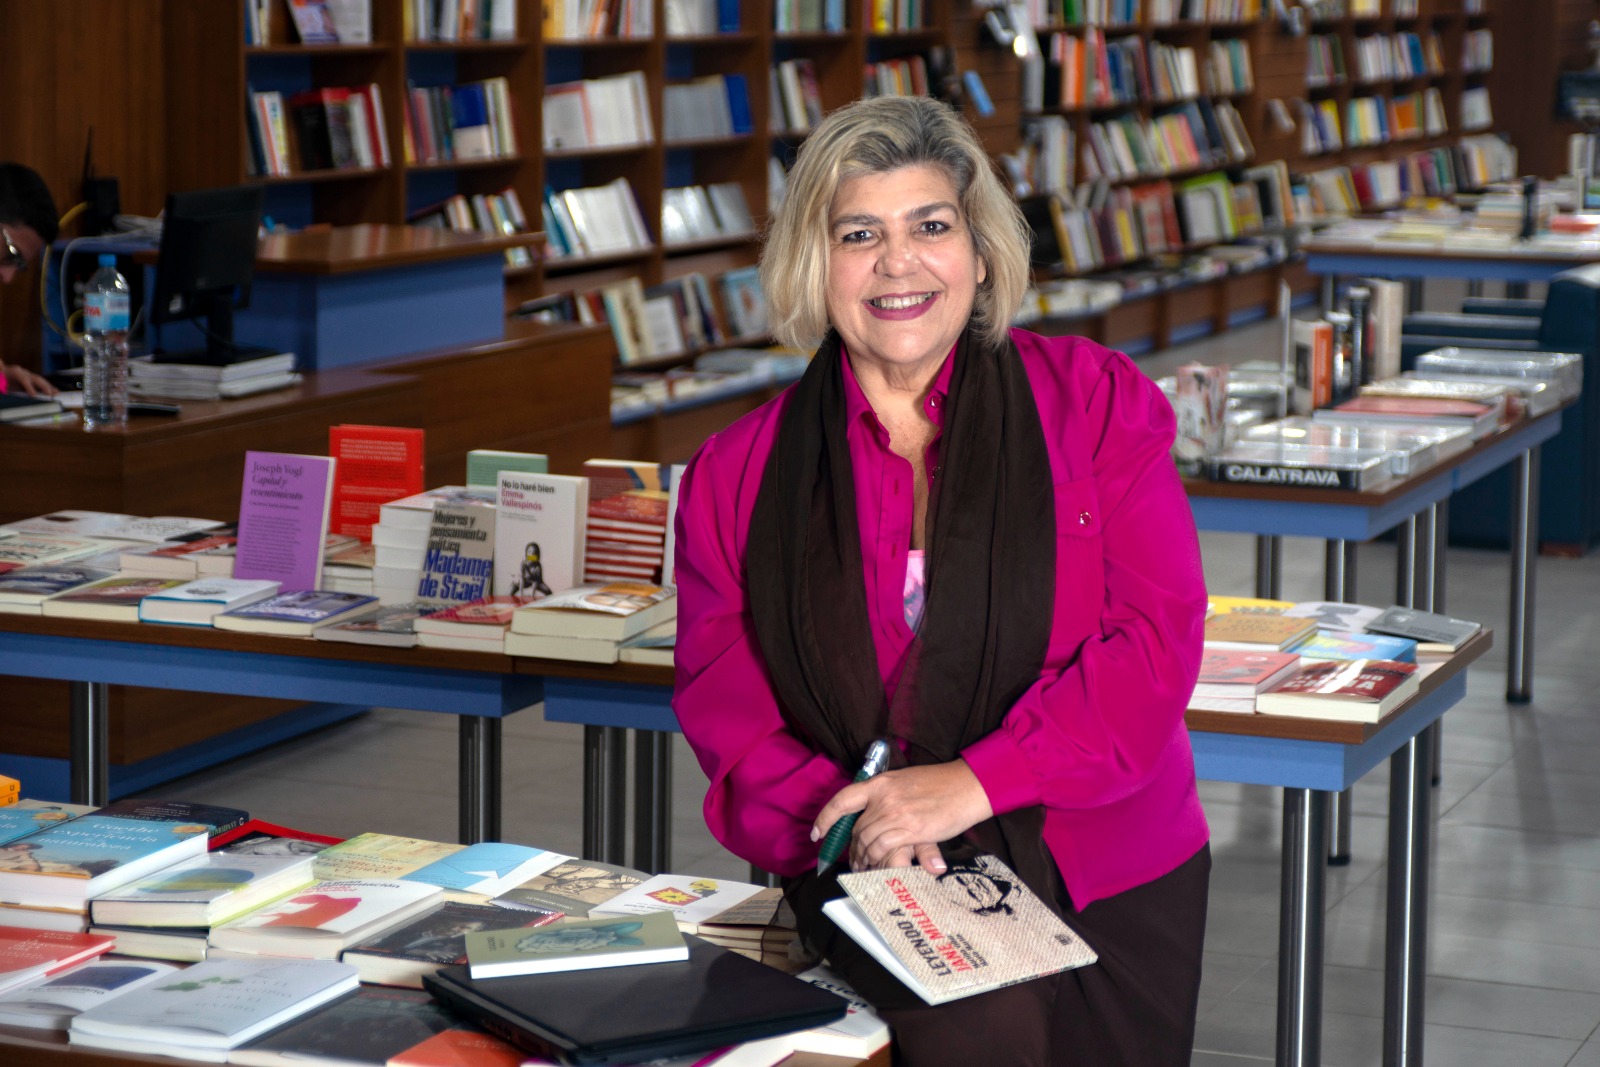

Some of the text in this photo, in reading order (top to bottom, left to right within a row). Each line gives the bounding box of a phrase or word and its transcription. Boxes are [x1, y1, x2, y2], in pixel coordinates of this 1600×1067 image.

[252, 461, 303, 477] Joseph Vogl
[1225, 465, 1341, 486] CALATRAVA
[250, 488, 303, 500] resentimiento
[501, 480, 555, 493] No lo haré bien
[501, 489, 524, 499] Emma
[432, 510, 475, 528] Mujeres y
[423, 548, 494, 577] Madame
[418, 573, 486, 602] de Staël
[885, 877, 974, 972] JANE MILLARES
[888, 908, 952, 977] LEYENDO A
